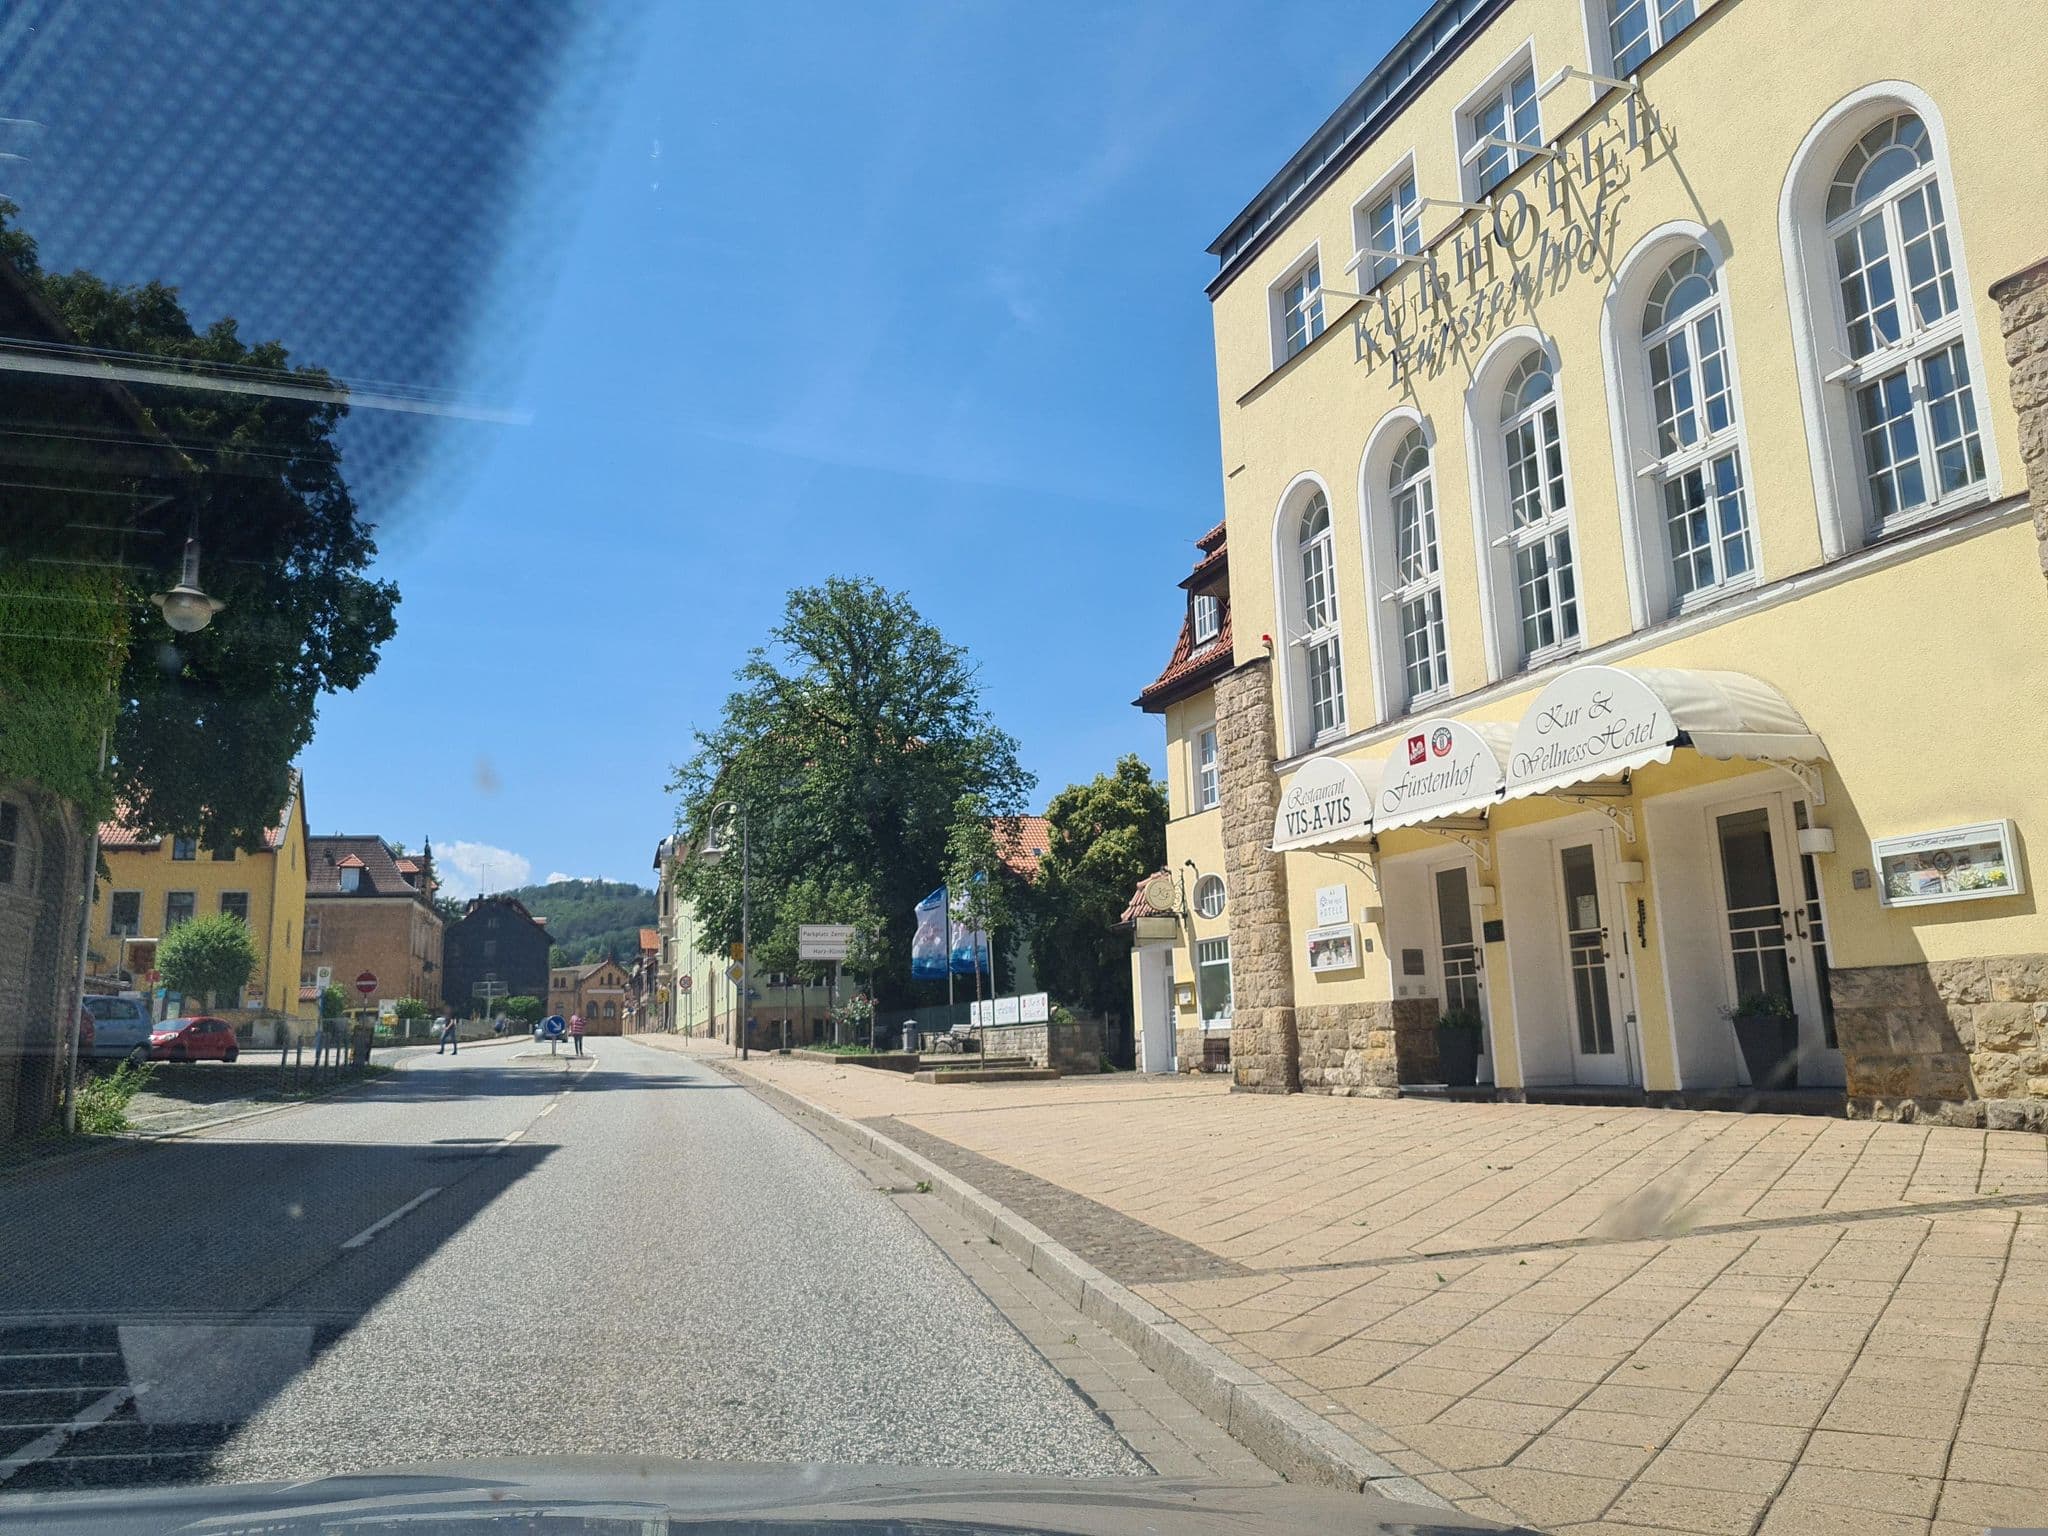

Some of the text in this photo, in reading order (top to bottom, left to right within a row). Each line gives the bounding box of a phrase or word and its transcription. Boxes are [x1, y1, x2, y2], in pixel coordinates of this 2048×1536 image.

[1353, 94, 1662, 364] KURHOTEL
[1536, 688, 1614, 735] Kur &
[1287, 777, 1345, 810] Restaurant
[1383, 752, 1480, 813] Fürstenhof
[1286, 796, 1351, 837] VIS-A-VIS
